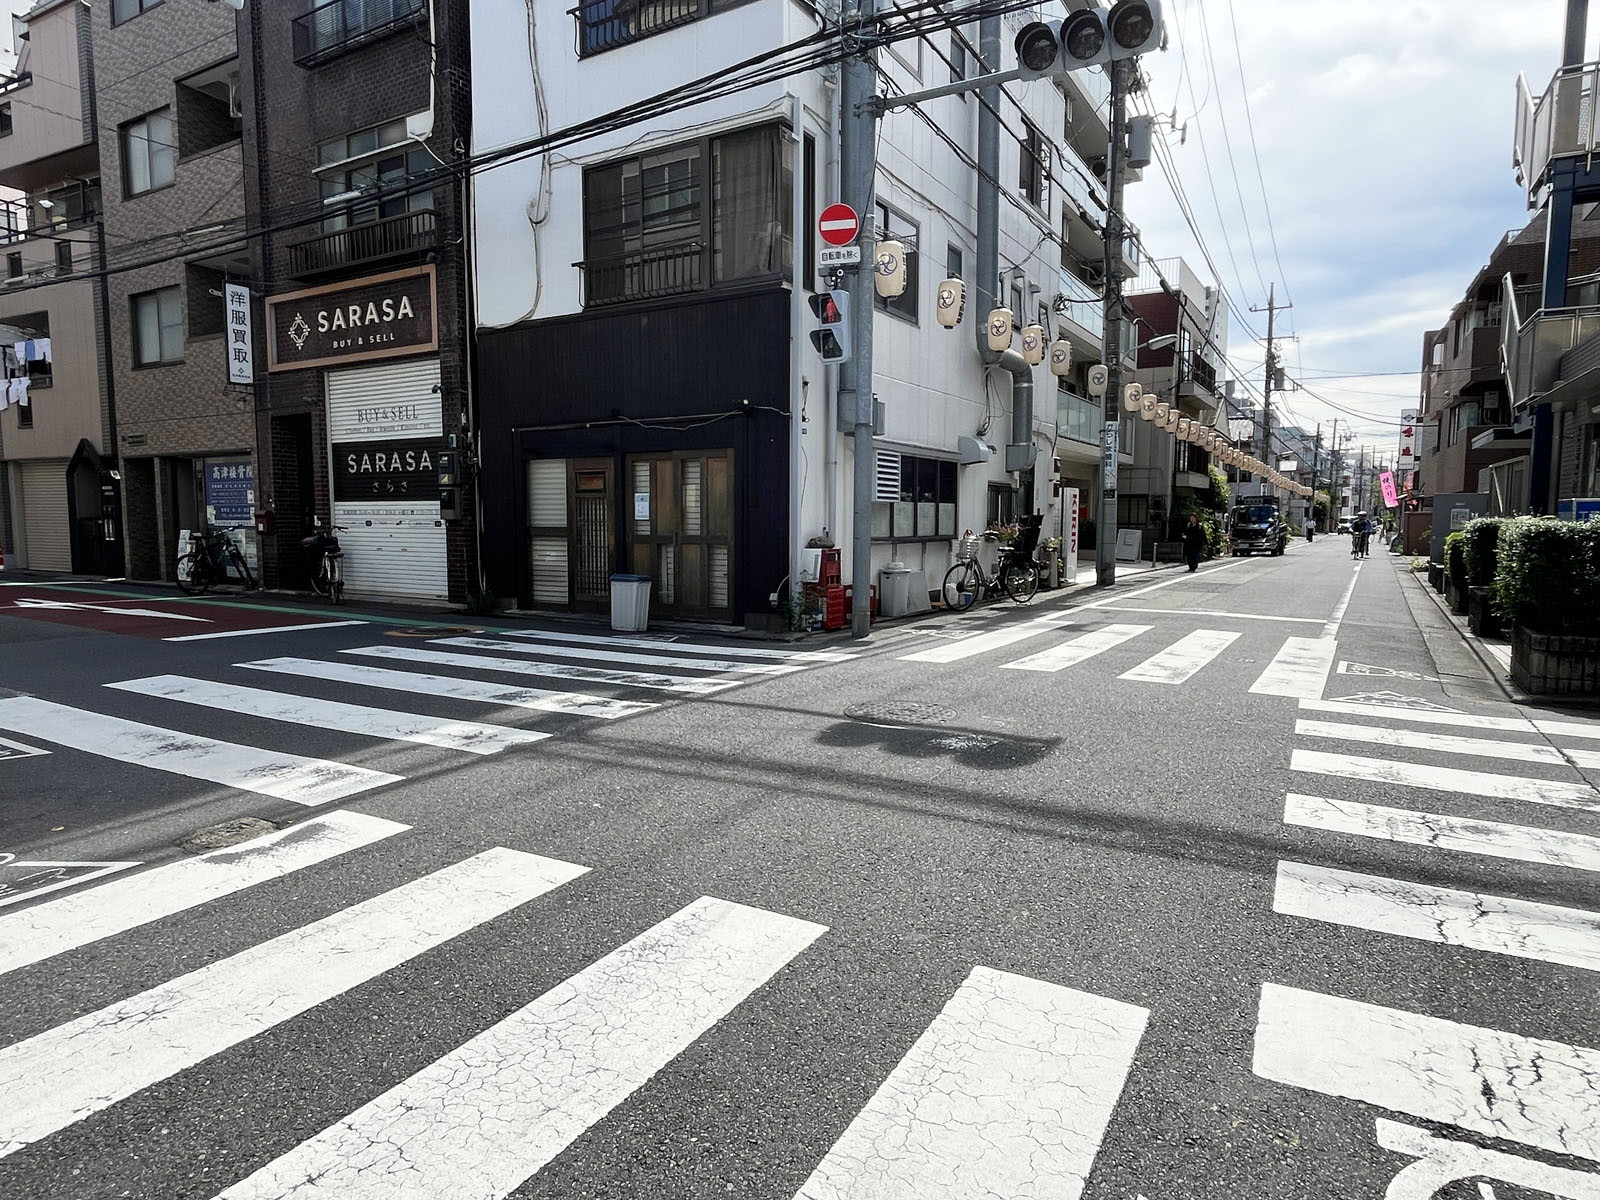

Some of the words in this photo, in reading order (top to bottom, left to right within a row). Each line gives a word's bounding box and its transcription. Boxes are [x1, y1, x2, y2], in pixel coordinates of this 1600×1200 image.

[317, 295, 415, 333] SARASA
[230, 290, 249, 364] 洋服買取
[333, 339, 352, 349] BUY
[369, 332, 396, 344] SELL
[347, 449, 433, 474] SARASA
[372, 480, 408, 493] さらさ
